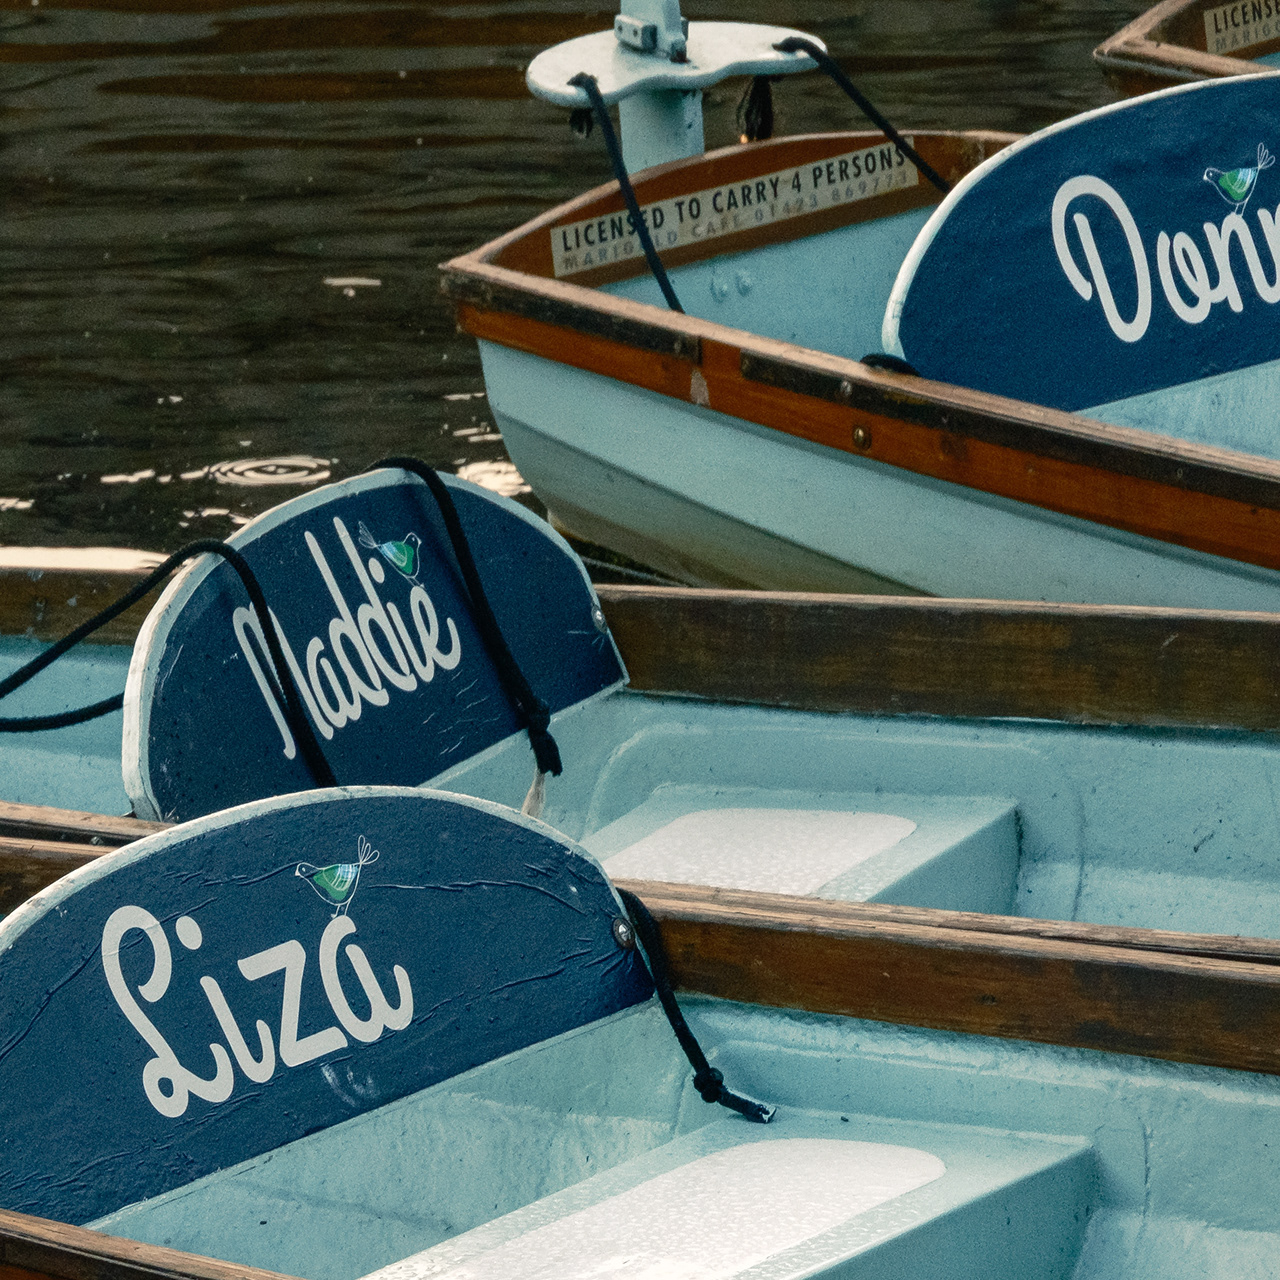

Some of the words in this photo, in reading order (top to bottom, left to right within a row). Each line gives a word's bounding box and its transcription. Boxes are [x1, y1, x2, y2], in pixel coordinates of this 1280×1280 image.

[563, 230, 679, 271] MARIGLD
[675, 197, 701, 223] TO
[712, 176, 779, 213] CARRY
[792, 170, 803, 193] 4
[812, 146, 906, 188] PERSONS
[233, 516, 462, 760] Maddie
[102, 905, 413, 1118] Liza
